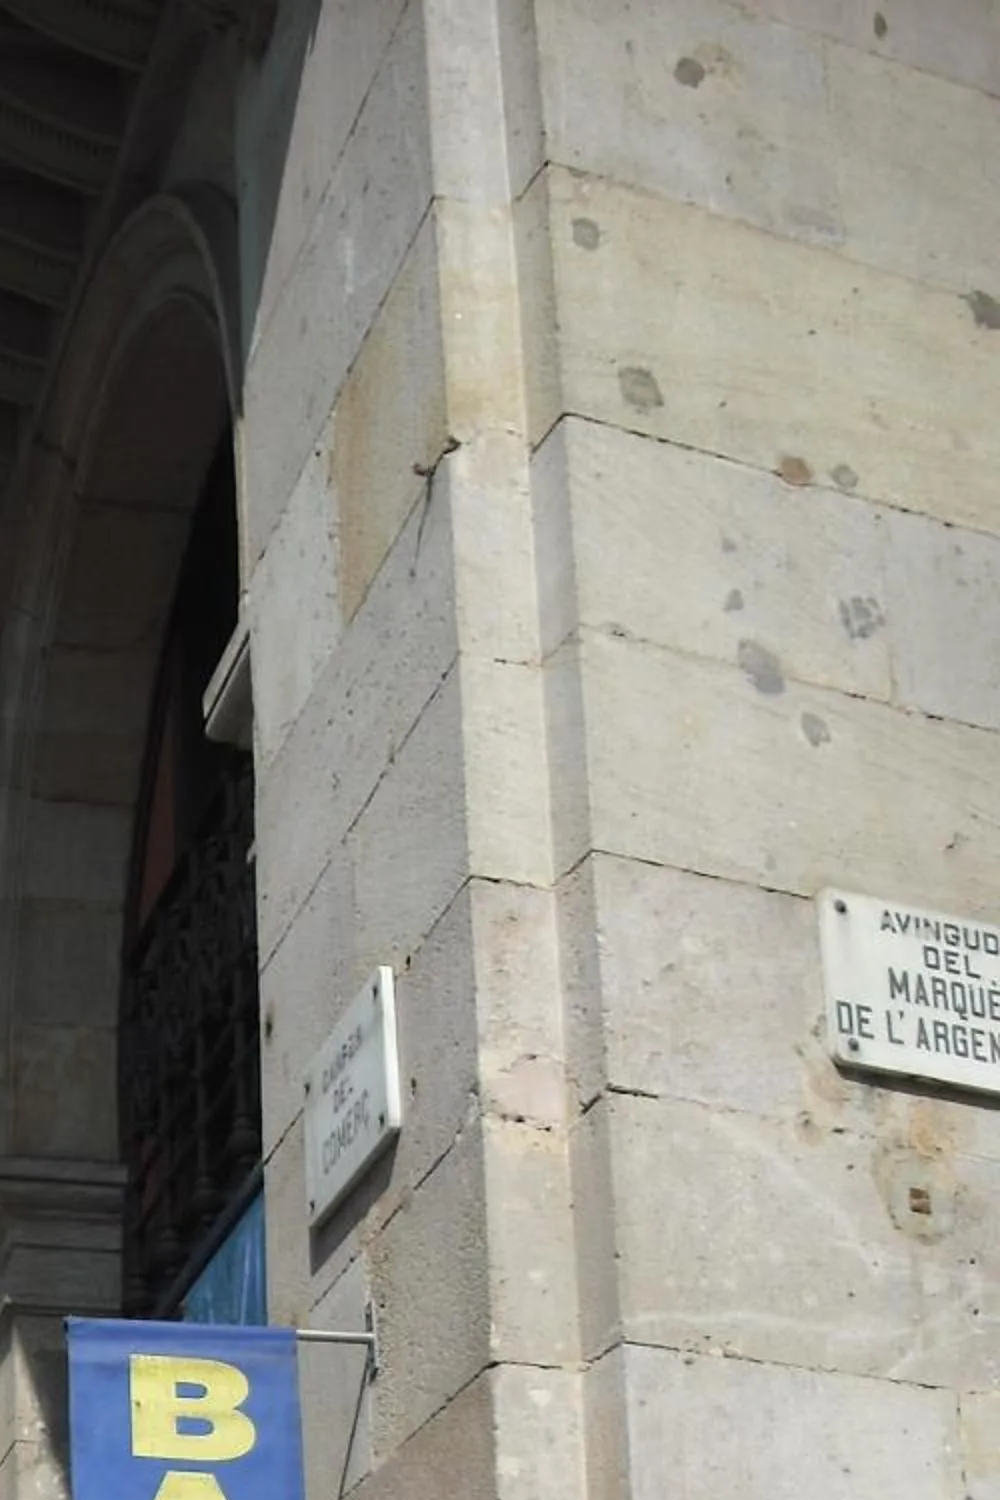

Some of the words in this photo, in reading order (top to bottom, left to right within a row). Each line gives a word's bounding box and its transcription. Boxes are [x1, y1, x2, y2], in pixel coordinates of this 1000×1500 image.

[879, 908, 1000, 956] AVINGUD
[923, 944, 982, 979] DEL
[887, 966, 1000, 1022] MARQUÈ
[835, 999, 875, 1040] DE
[885, 1009, 1000, 1064] L'ARGEN
